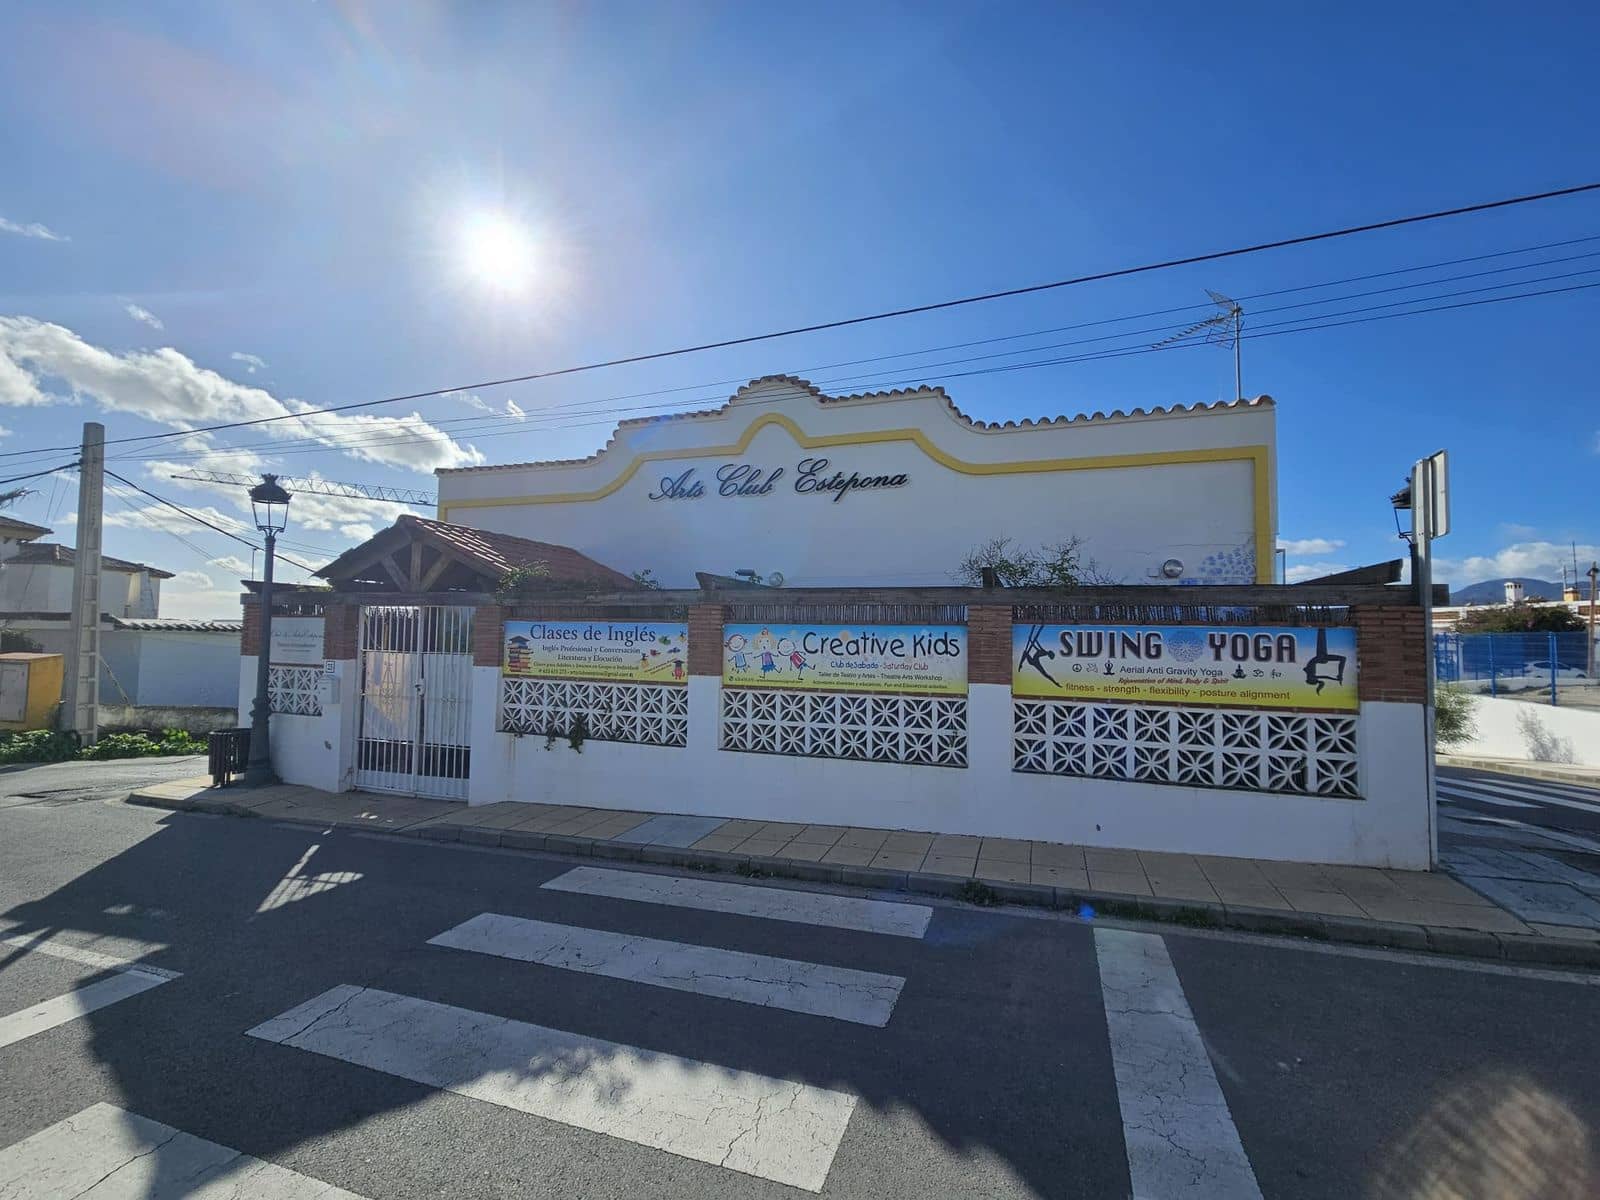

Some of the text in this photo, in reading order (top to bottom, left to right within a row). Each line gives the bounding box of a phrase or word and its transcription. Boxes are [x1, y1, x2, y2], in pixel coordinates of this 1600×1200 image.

[649, 458, 908, 502] Arts Club Estepona
[530, 624, 656, 647] Clases de Inglés
[560, 644, 593, 653] Profesional
[599, 645, 641, 655] Conversación
[803, 631, 961, 659] Creative Kids
[1059, 630, 1297, 664] SWING YOGA
[557, 653, 587, 662] Literatura
[593, 654, 623, 664] Elocución
[830, 660, 845, 669] Club
[883, 661, 912, 671] Saturday
[913, 661, 929, 671] Club
[914, 674, 943, 682] Workshop
[1120, 665, 1223, 678] Aerial Anti Gravity Yoga
[1066, 682, 1095, 692] fitness
[1103, 684, 1141, 695] strength
[1149, 685, 1191, 696] flexibility
[1199, 688, 1237, 699] posture
[1239, 688, 1290, 700] alignment
